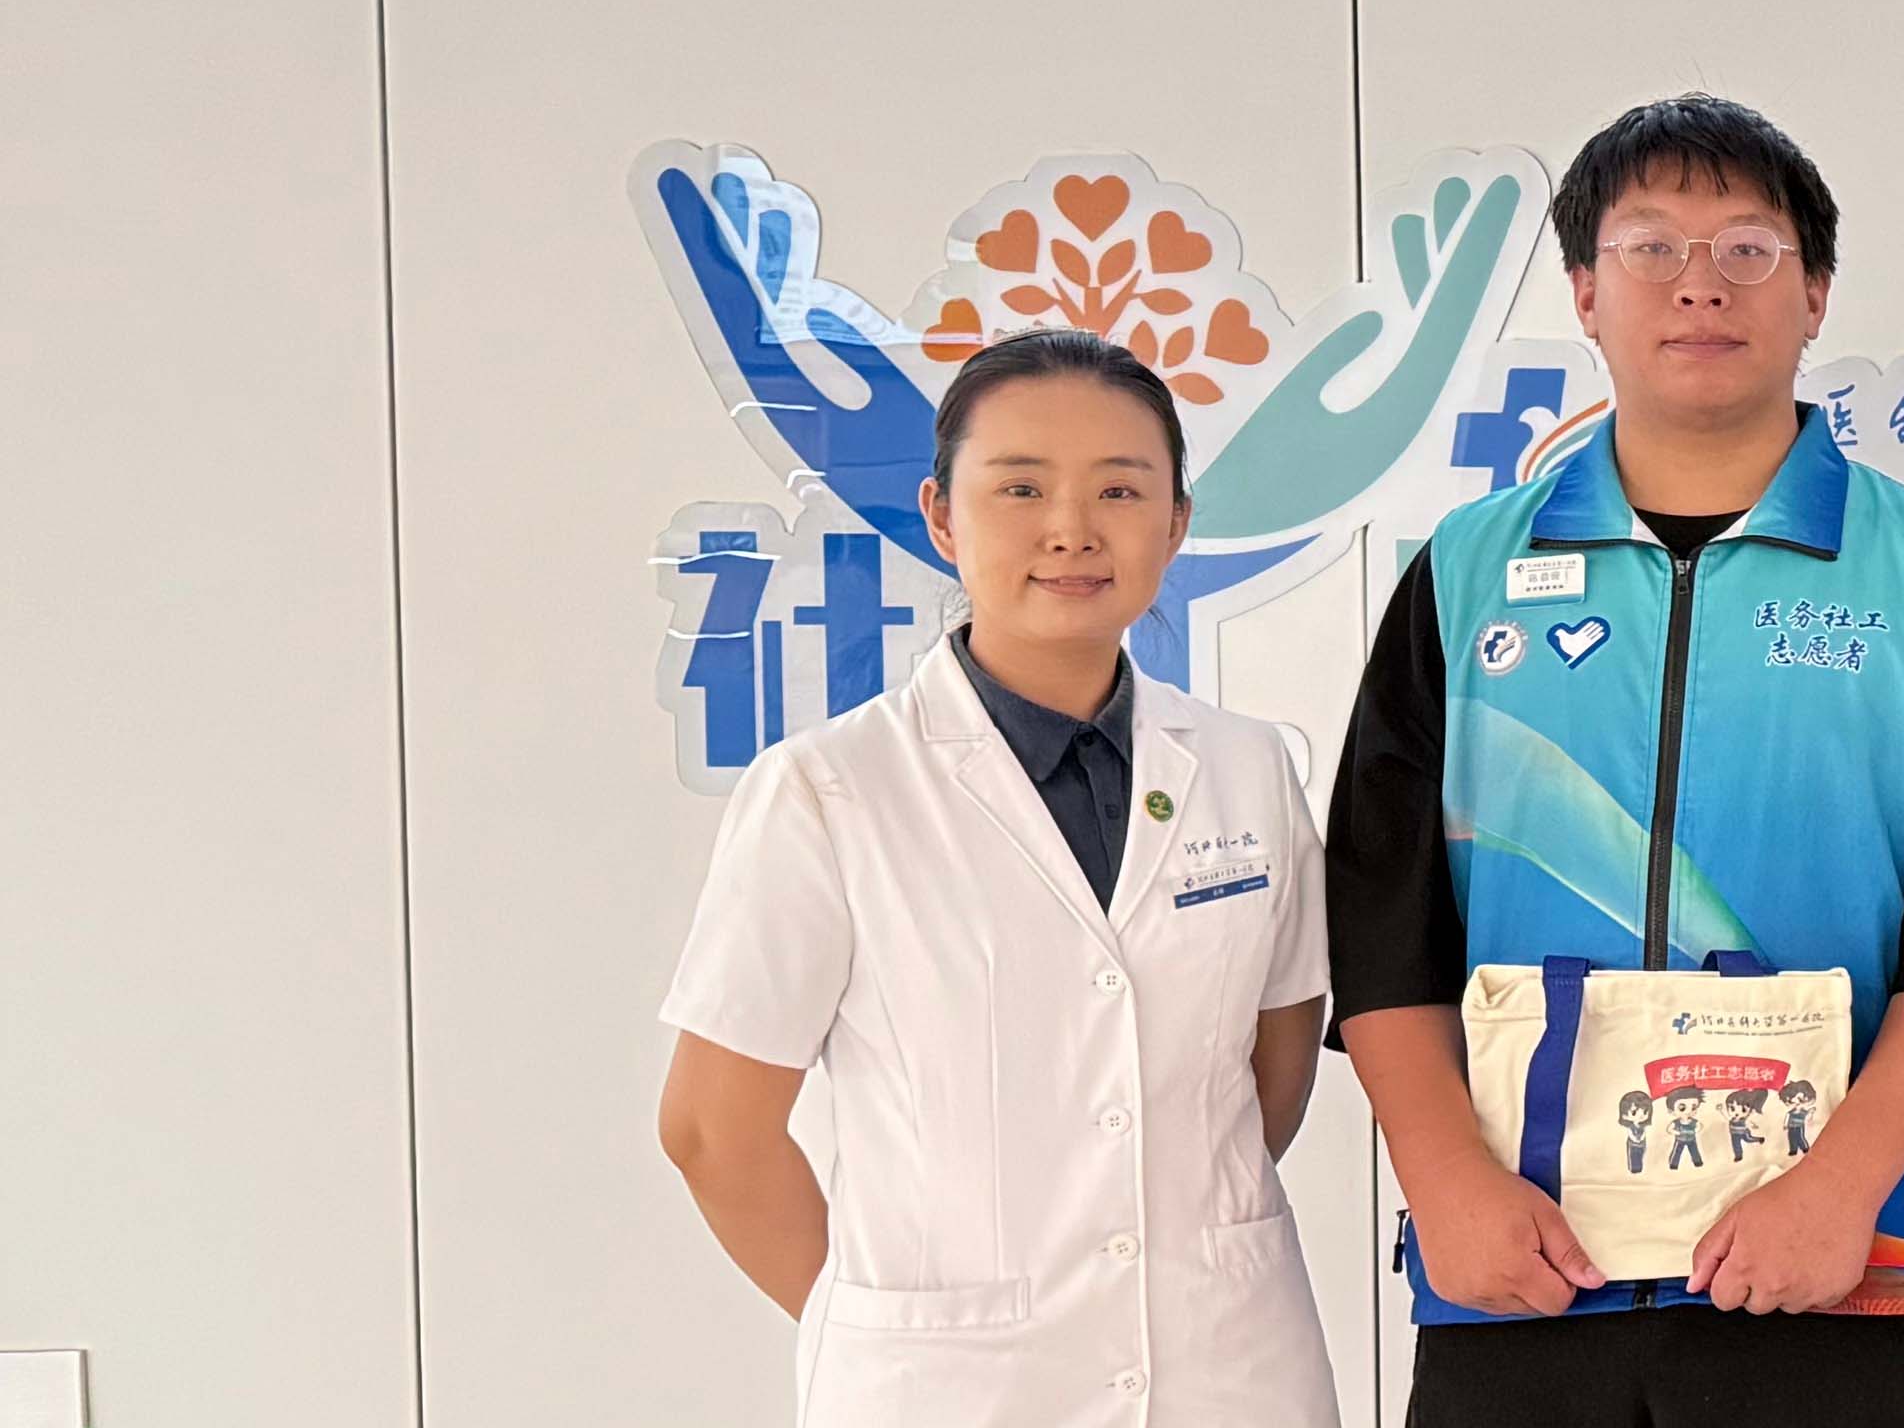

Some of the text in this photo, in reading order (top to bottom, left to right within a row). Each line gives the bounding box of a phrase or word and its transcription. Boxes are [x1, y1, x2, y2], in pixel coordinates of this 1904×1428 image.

[1754, 600, 1889, 632] 医务社工
[1765, 632, 1867, 673] 志愿者
[1660, 1064, 1777, 1085] 医务社工志愿者
